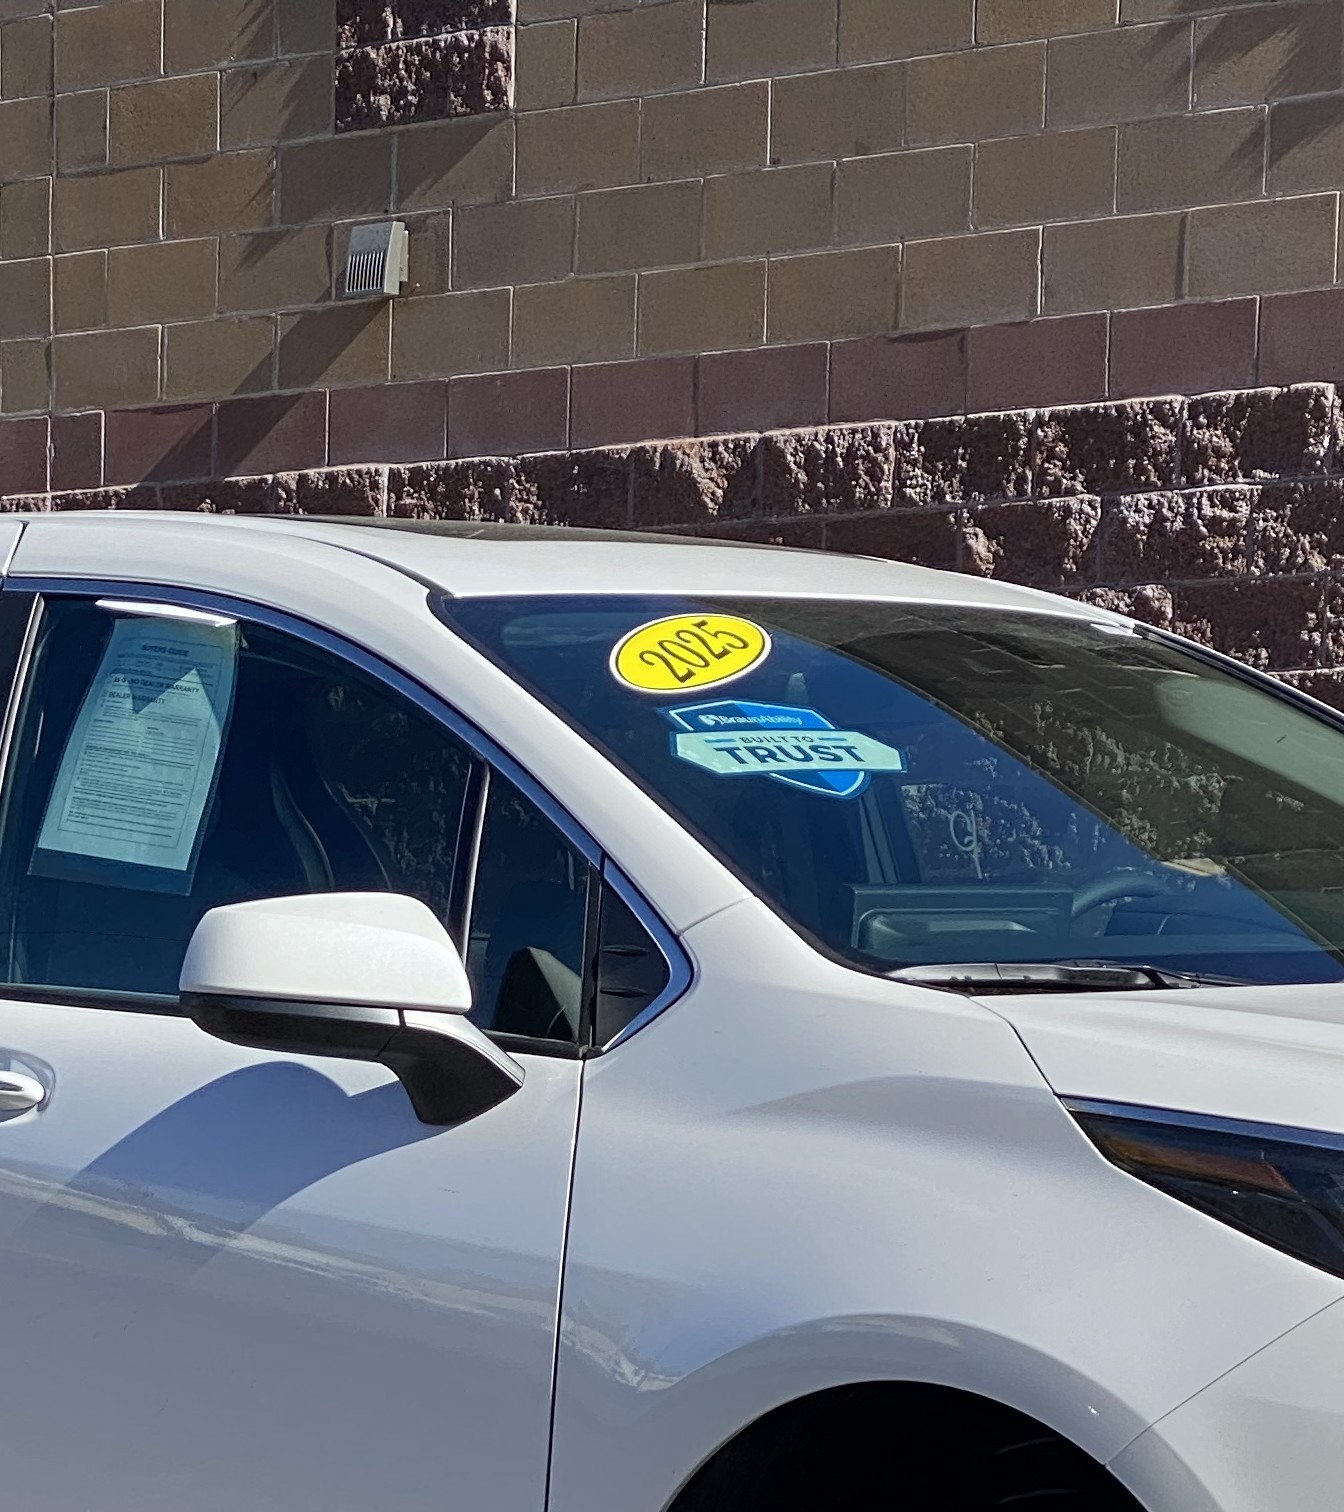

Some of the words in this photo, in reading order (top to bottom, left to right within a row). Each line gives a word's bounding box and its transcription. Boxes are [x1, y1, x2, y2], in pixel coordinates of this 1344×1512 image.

[640, 619, 749, 684] 2025
[739, 736, 788, 744] BUILT
[715, 744, 866, 765] TRUST
